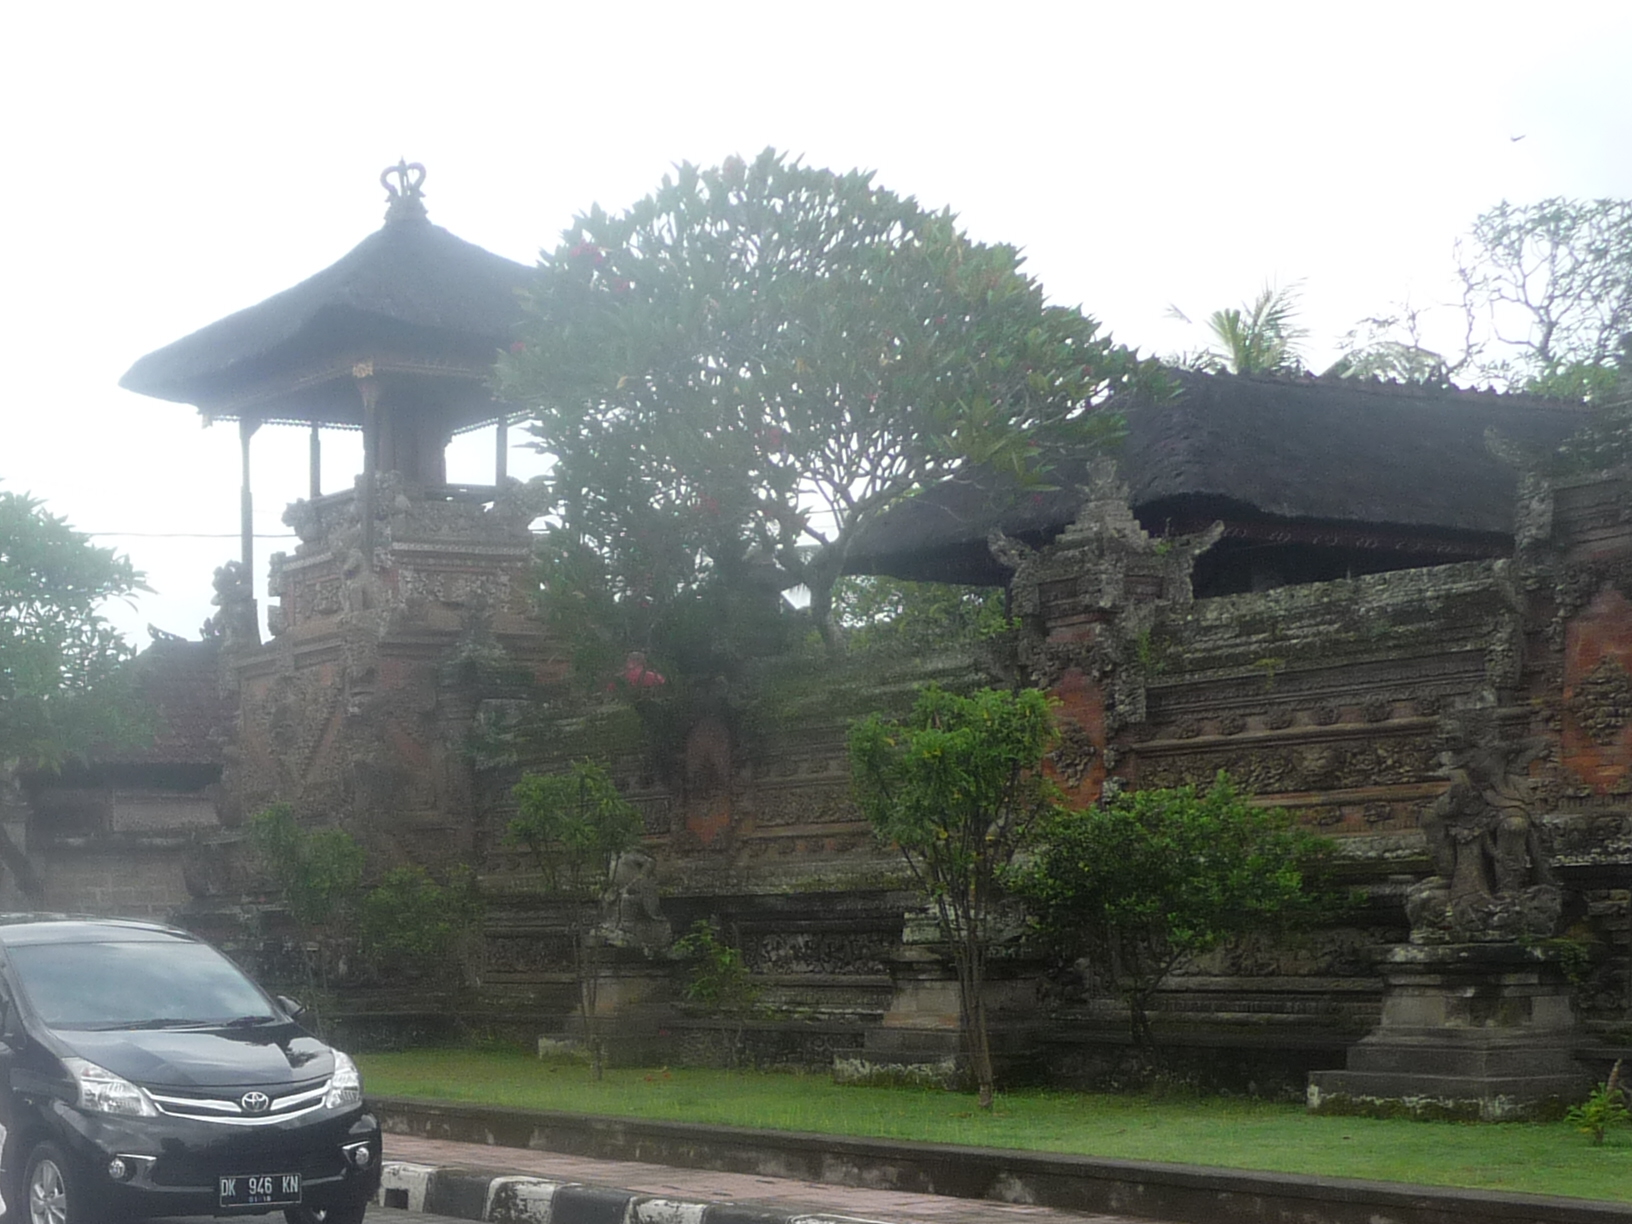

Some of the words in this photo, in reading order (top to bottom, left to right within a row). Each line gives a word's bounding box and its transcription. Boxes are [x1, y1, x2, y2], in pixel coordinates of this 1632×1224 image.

[221, 1179, 236, 1196] DK
[249, 1177, 273, 1195] 946
[282, 1175, 299, 1193] KN
